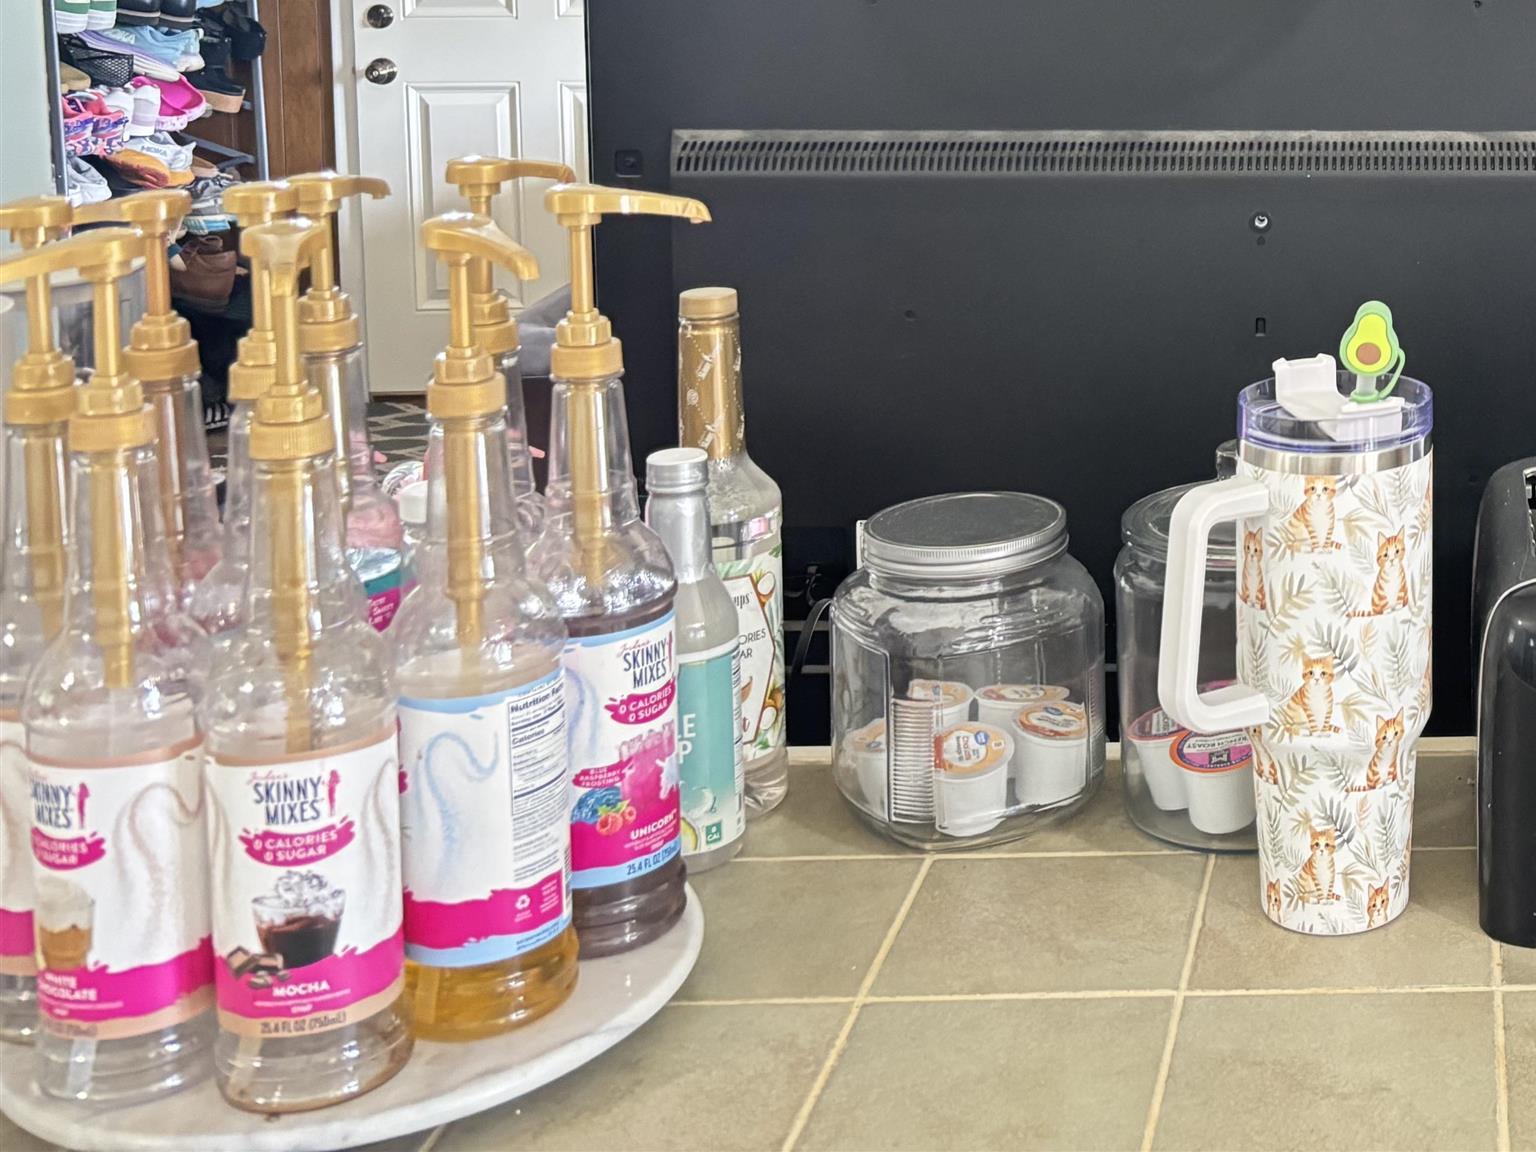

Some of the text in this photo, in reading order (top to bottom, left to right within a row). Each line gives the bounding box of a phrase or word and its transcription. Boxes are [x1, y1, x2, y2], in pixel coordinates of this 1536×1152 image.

[623, 638, 667, 672] SKINNY
[632, 658, 667, 689] MIXES
[618, 684, 672, 715] 0 CALORIES
[628, 698, 669, 723] 0 SUGAR
[253, 775, 322, 805] SKINNY
[265, 798, 322, 826] MIXES
[253, 829, 338, 851] 0 CALORIES
[263, 844, 328, 863] 0 SUGAR
[626, 861, 643, 875] 25.4
[272, 979, 331, 998] MOCHA
